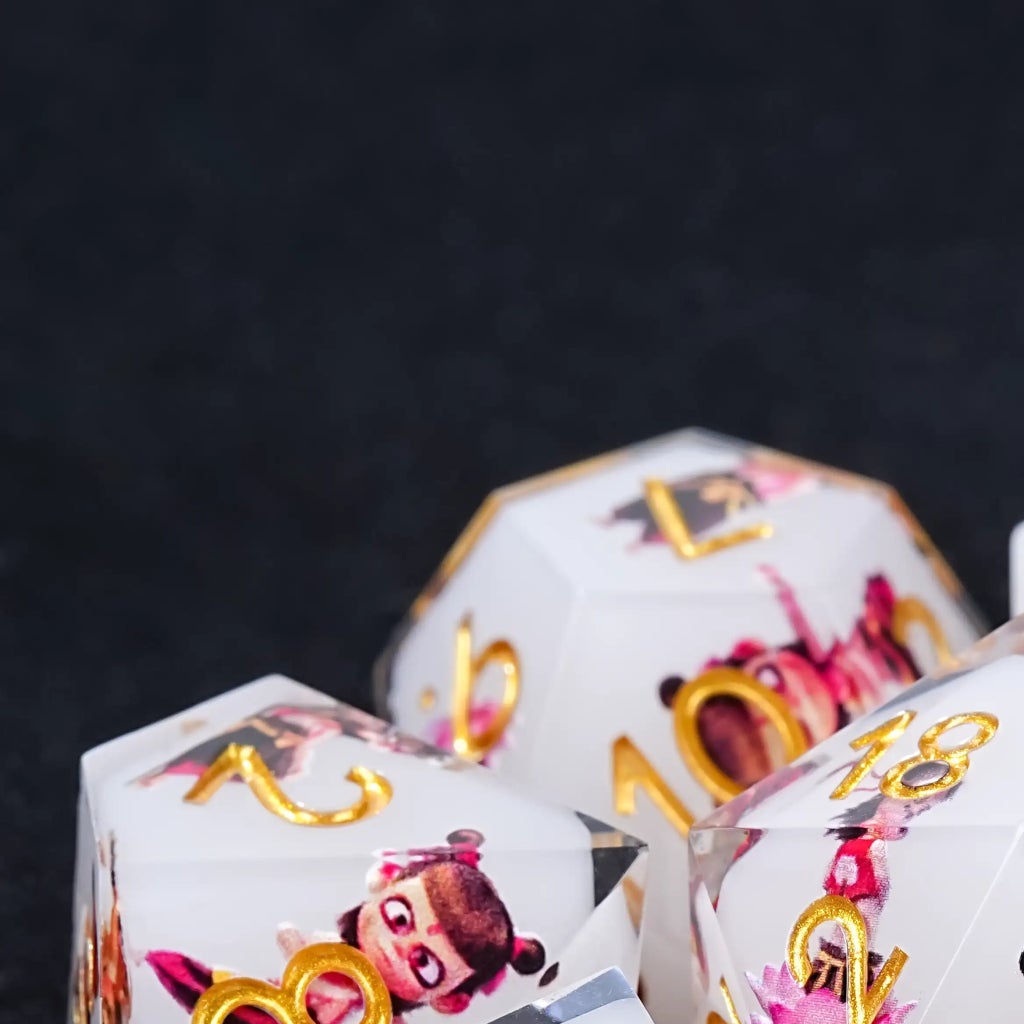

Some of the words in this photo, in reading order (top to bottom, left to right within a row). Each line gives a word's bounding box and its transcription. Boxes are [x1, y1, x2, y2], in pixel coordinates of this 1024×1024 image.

[183, 741, 392, 826] 2
[611, 667, 806, 839] 10
[830, 710, 999, 800] 18
